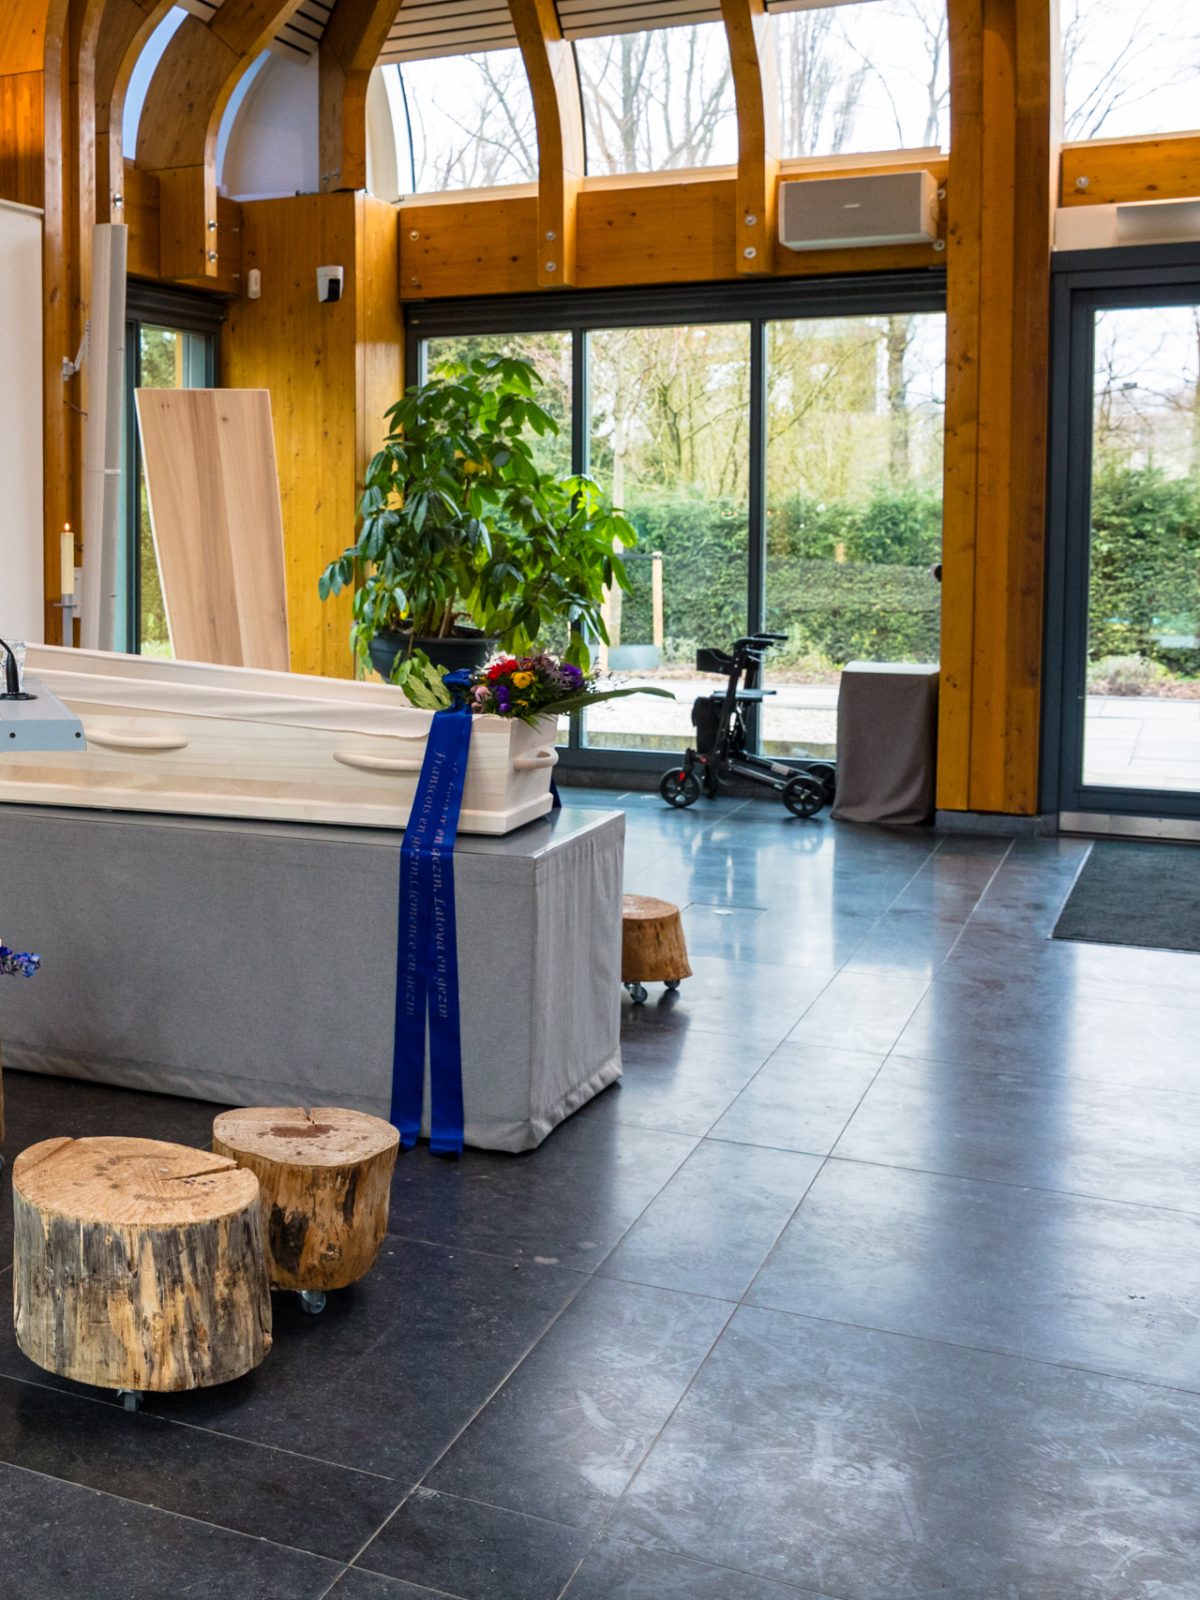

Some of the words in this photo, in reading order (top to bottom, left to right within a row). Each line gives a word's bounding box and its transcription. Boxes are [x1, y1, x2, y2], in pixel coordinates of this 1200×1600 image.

[417, 817, 427, 832] en
[433, 828, 445, 844] en
[434, 896, 446, 950] Latoya
[408, 954, 416, 970] en
[436, 955, 447, 973] en
[403, 974, 415, 1015] gezin
[433, 976, 449, 1019] gezin
